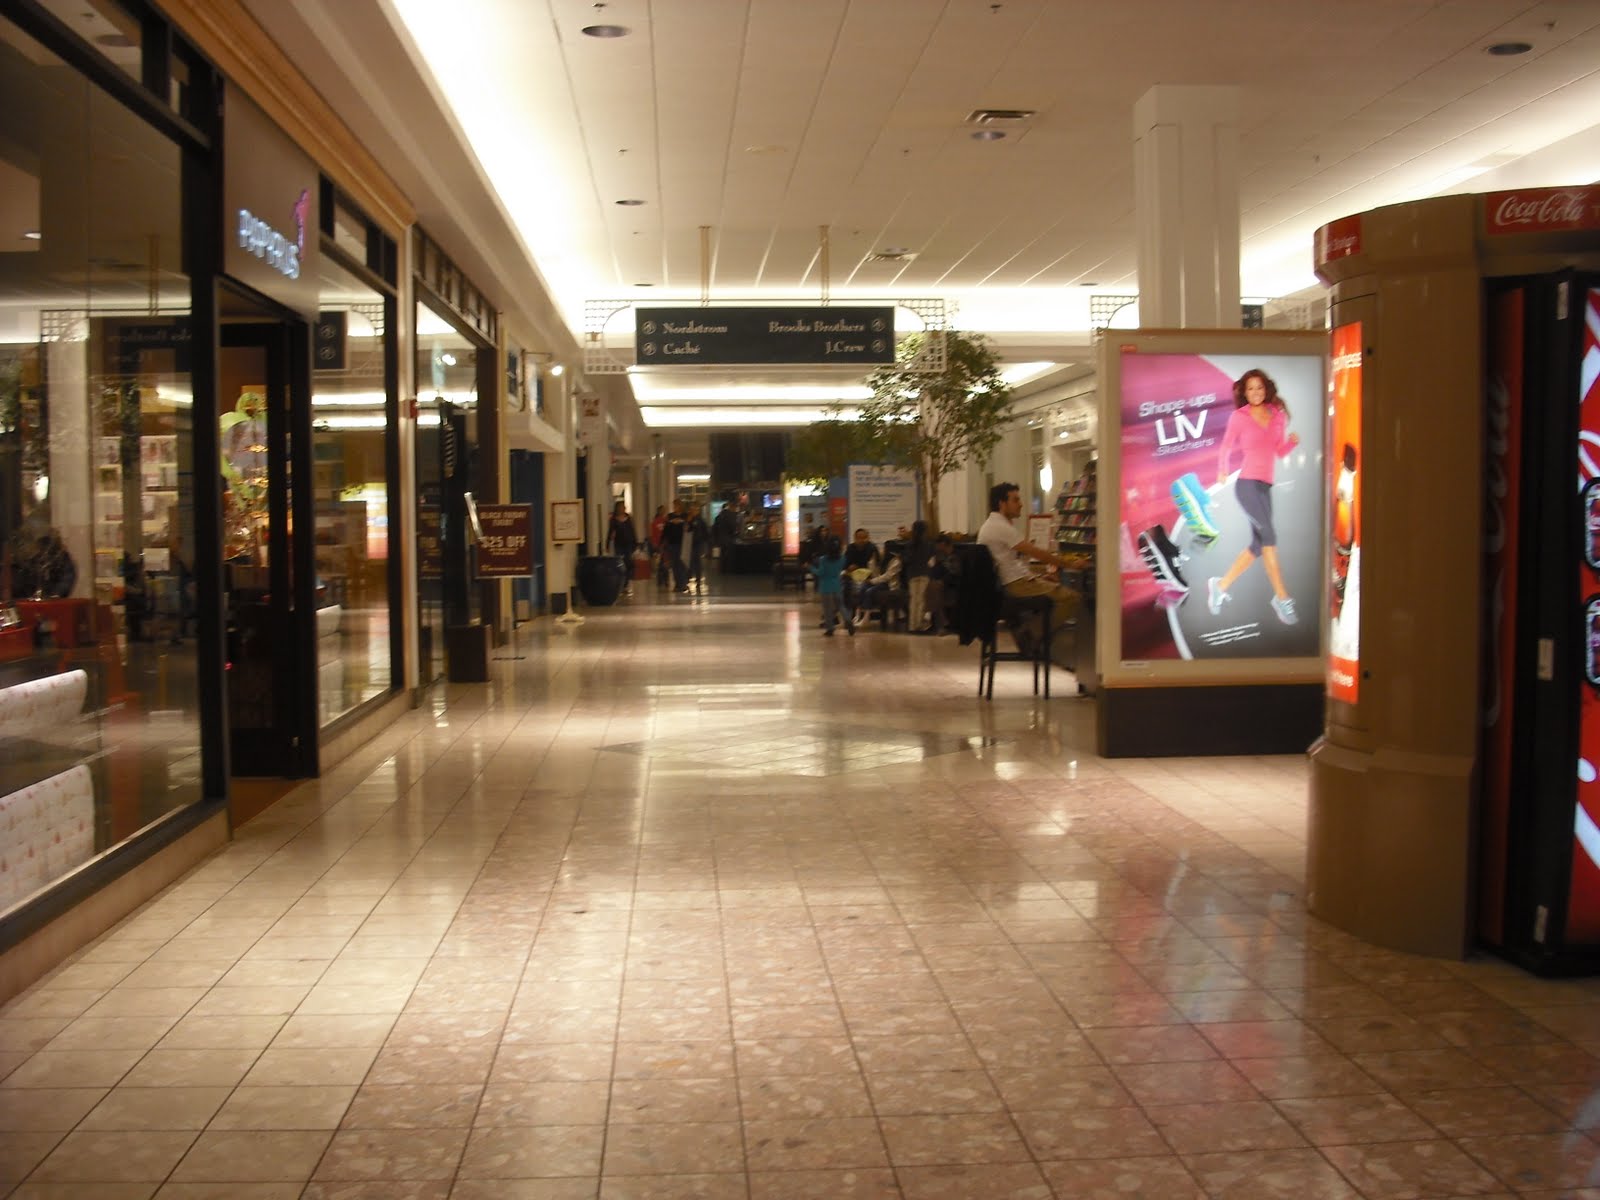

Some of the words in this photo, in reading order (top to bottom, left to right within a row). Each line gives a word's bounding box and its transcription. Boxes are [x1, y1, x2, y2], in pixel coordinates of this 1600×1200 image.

[1494, 189, 1592, 226] Coca-Cola
[662, 320, 728, 334] Nordstrom
[768, 319, 812, 333] Brooks
[813, 319, 866, 333] Brothers
[506, 535, 527, 548] OFF
